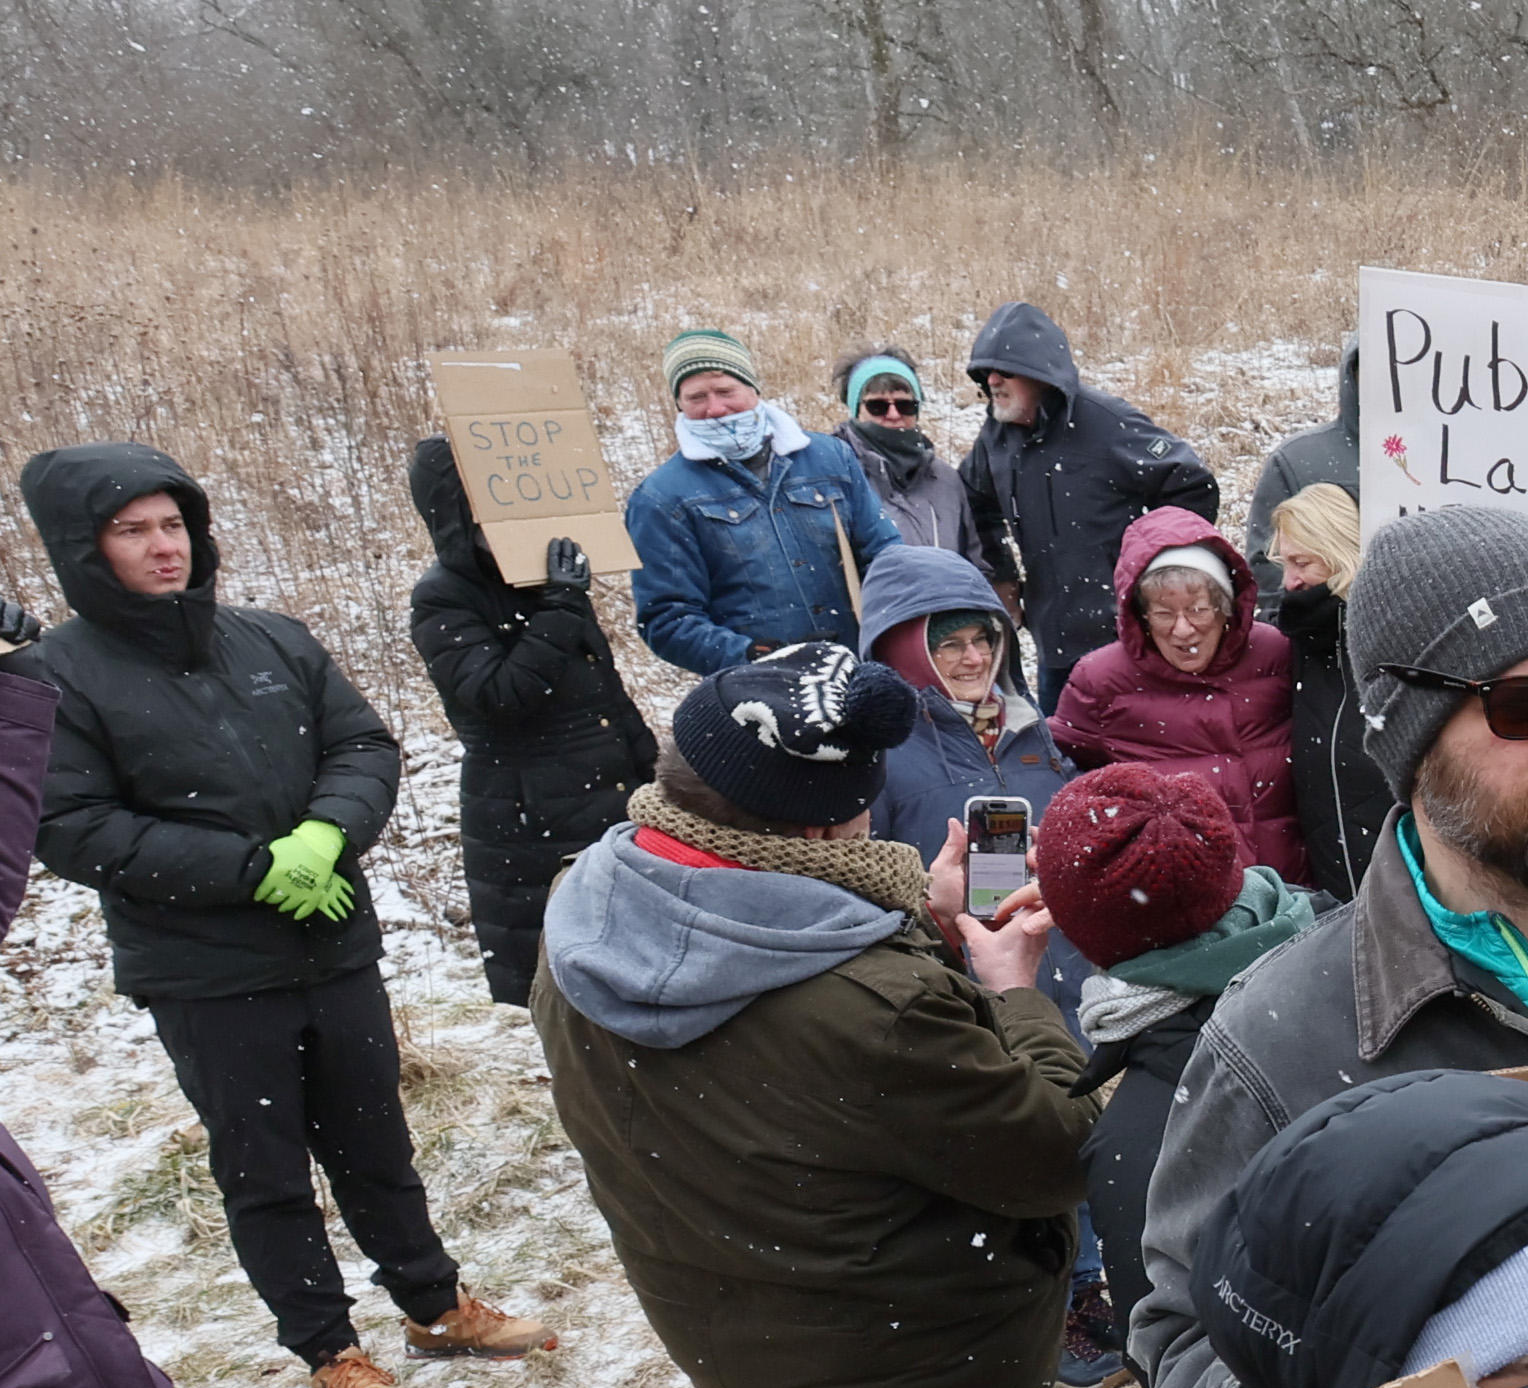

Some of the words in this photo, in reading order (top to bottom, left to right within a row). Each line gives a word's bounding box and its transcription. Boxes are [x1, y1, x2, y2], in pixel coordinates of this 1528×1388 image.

[469, 420, 563, 451] STOP
[496, 452, 542, 470] THE
[488, 467, 600, 506] COUP
